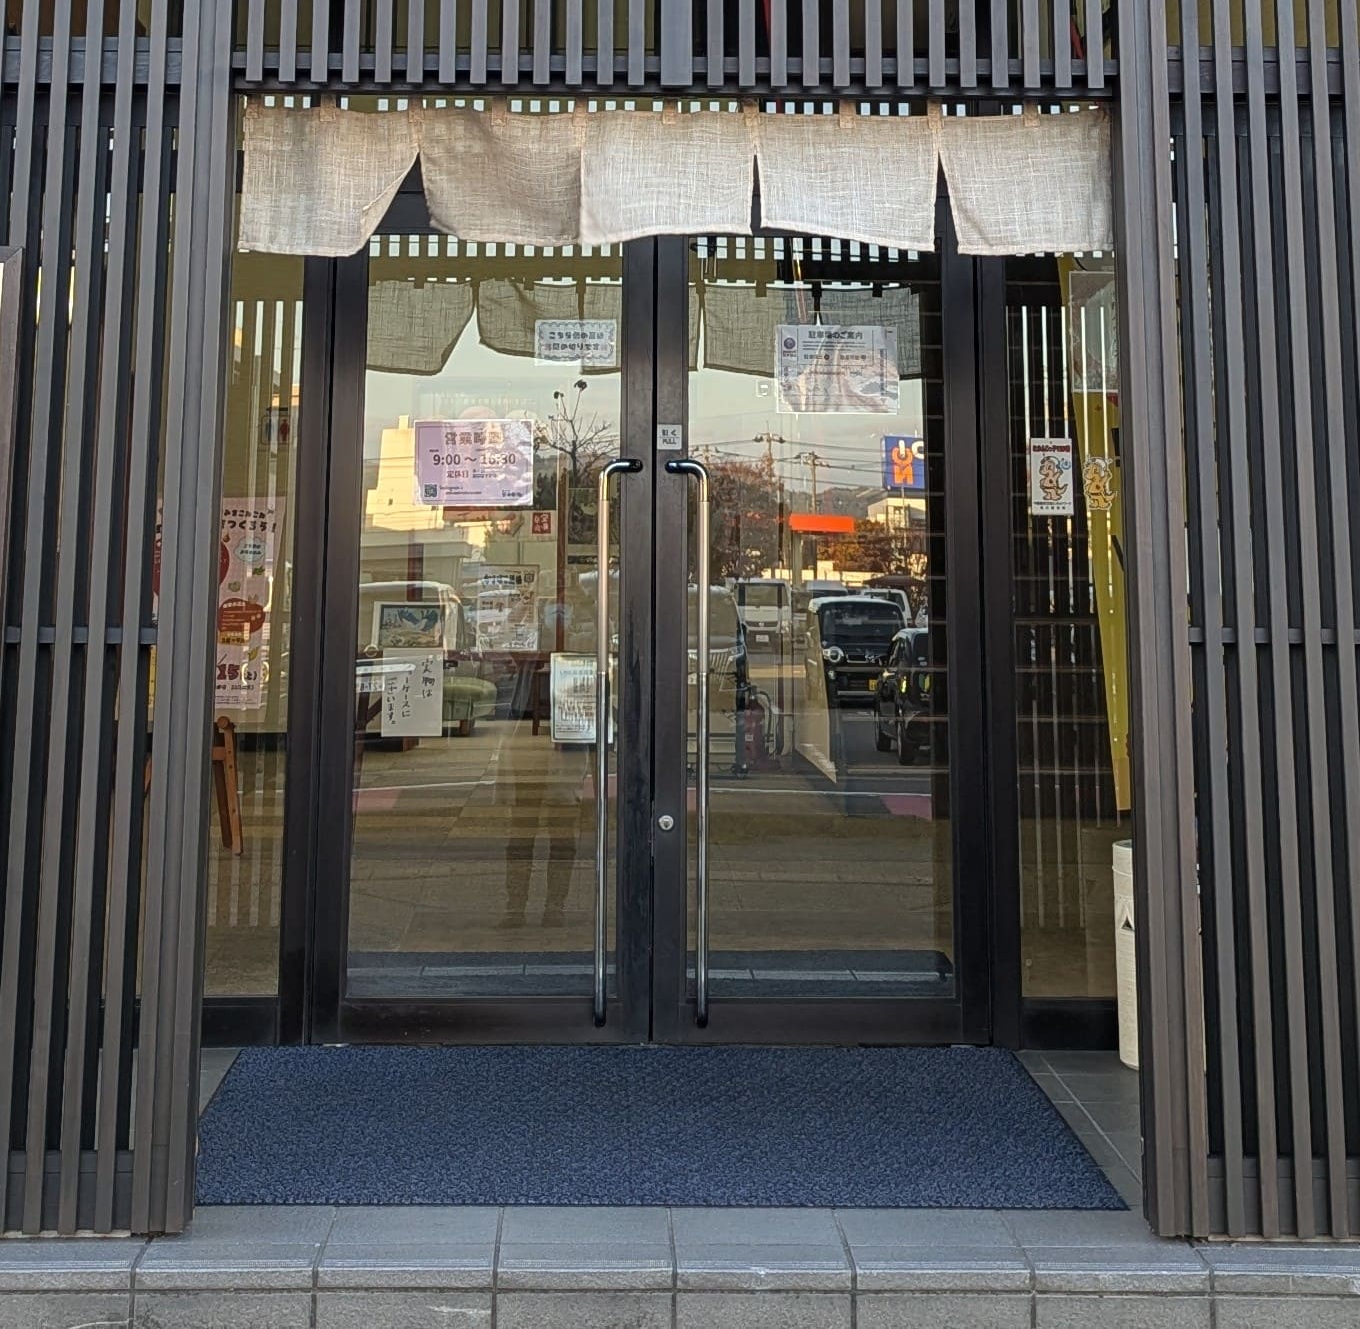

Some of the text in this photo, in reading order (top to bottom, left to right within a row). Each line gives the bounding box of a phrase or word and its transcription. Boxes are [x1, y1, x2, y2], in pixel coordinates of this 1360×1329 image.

[808, 330, 863, 340] 駐車場のご案内
[444, 431, 501, 446] 営業時間
[432, 453, 461, 466] 9:00
[480, 453, 516, 465] 16:30
[446, 470, 469, 479] 定休日
